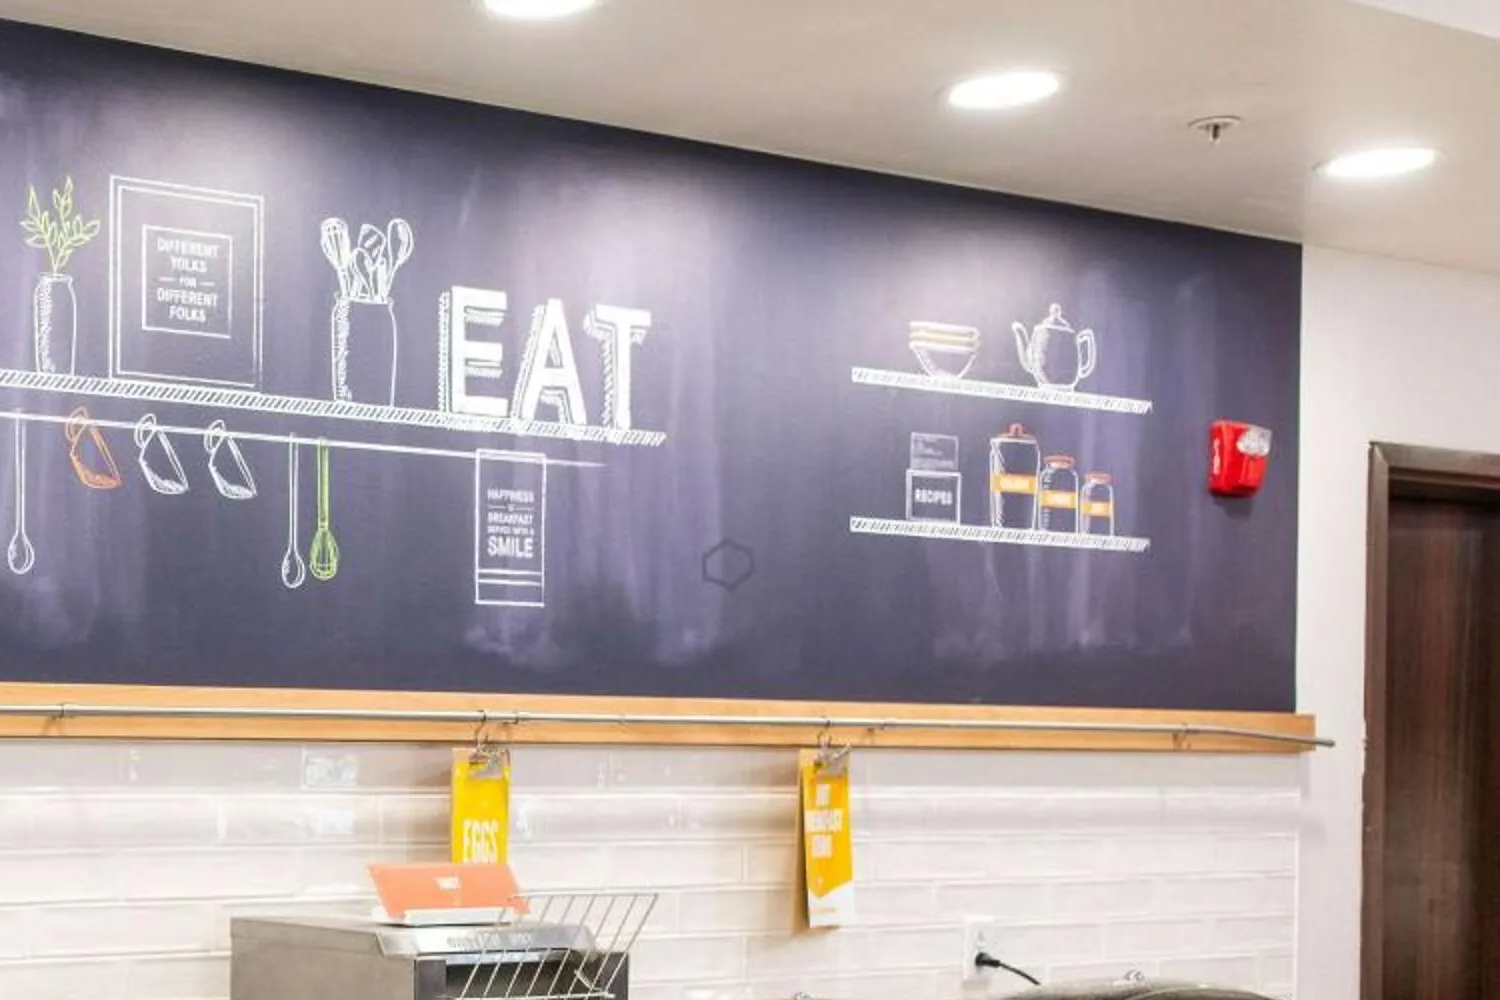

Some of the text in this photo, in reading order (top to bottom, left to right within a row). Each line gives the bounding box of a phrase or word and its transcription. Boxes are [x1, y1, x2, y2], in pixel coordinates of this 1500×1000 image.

[170, 256, 207, 273] YOLKS
[157, 287, 218, 307] DIFFERENT
[169, 305, 206, 323] FOLKS
[440, 286, 652, 431] EAT
[914, 488, 953, 505] RECIPES
[487, 535, 533, 558] SMILE
[463, 819, 499, 863] EGGS
